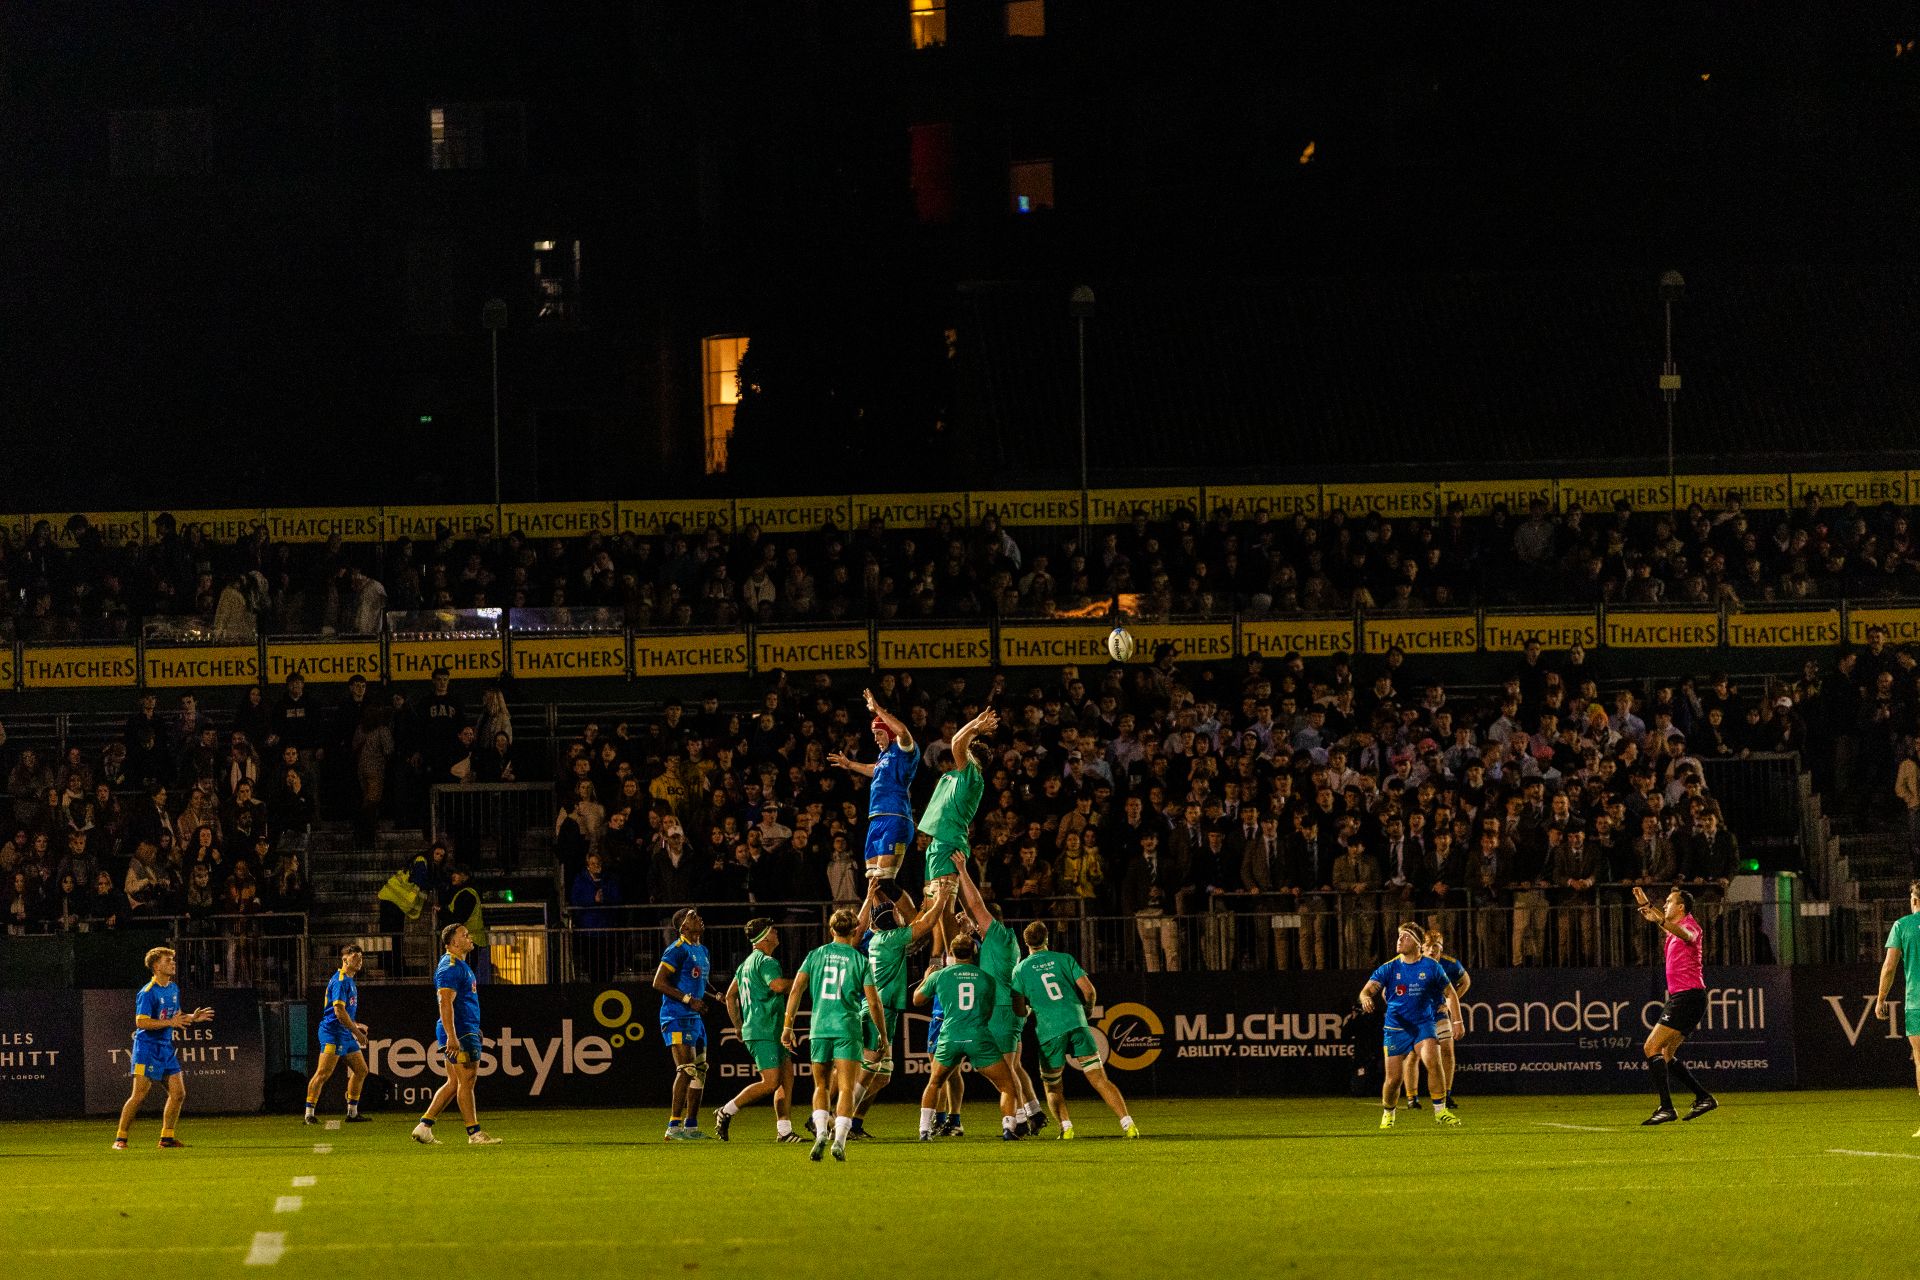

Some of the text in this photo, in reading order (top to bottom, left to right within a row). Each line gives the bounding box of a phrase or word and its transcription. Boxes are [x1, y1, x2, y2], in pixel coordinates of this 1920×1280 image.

[1563, 486, 1668, 507] THATCHERS
[1679, 483, 1784, 504] THATCHERS
[1796, 480, 1901, 501] THATCHERS
[855, 501, 962, 523] THATCHERS
[972, 499, 1081, 519] THATCHERS
[1209, 493, 1316, 514] THATCHERS
[1327, 491, 1433, 512] THATCHERS
[270, 515, 377, 536] THATCHERS
[503, 511, 611, 531] THATCHERS
[621, 509, 728, 530] THATCHERS
[739, 506, 846, 526] THATCHERS
[1245, 631, 1352, 651] THATCHERS
[1368, 628, 1475, 649] THATCHERS
[1486, 625, 1594, 646] THATCHERS
[1608, 623, 1716, 643] THATCHERS
[1731, 622, 1838, 643] THATCHERS
[638, 645, 746, 667] THATCHERS
[760, 642, 867, 662] THATCHERS
[881, 639, 989, 660] THATCHERS
[1004, 637, 1110, 657] THATCHERS
[25, 658, 135, 679] THATCHERS
[149, 657, 257, 679] THATCHERS
[271, 654, 378, 675] THATCHERS
[393, 651, 501, 672] THATCHERS
[515, 648, 623, 670] THATCHERS
[821, 966, 846, 1000] 21
[1041, 972, 1063, 1001] 6
[958, 982, 975, 1011] 8
[1641, 987, 1765, 1030] dffill
[1177, 1045, 1237, 1058] ABILITY.
[1240, 1045, 1312, 1057] DELIVERY.
[1579, 1037, 1632, 1049] Est 1947
[366, 1018, 613, 1096] reestyle
[1520, 1061, 1602, 1071] ACCOUNTANTS
[1616, 1061, 1650, 1071] TAX &
[1714, 1060, 1769, 1070] ADVISERS
